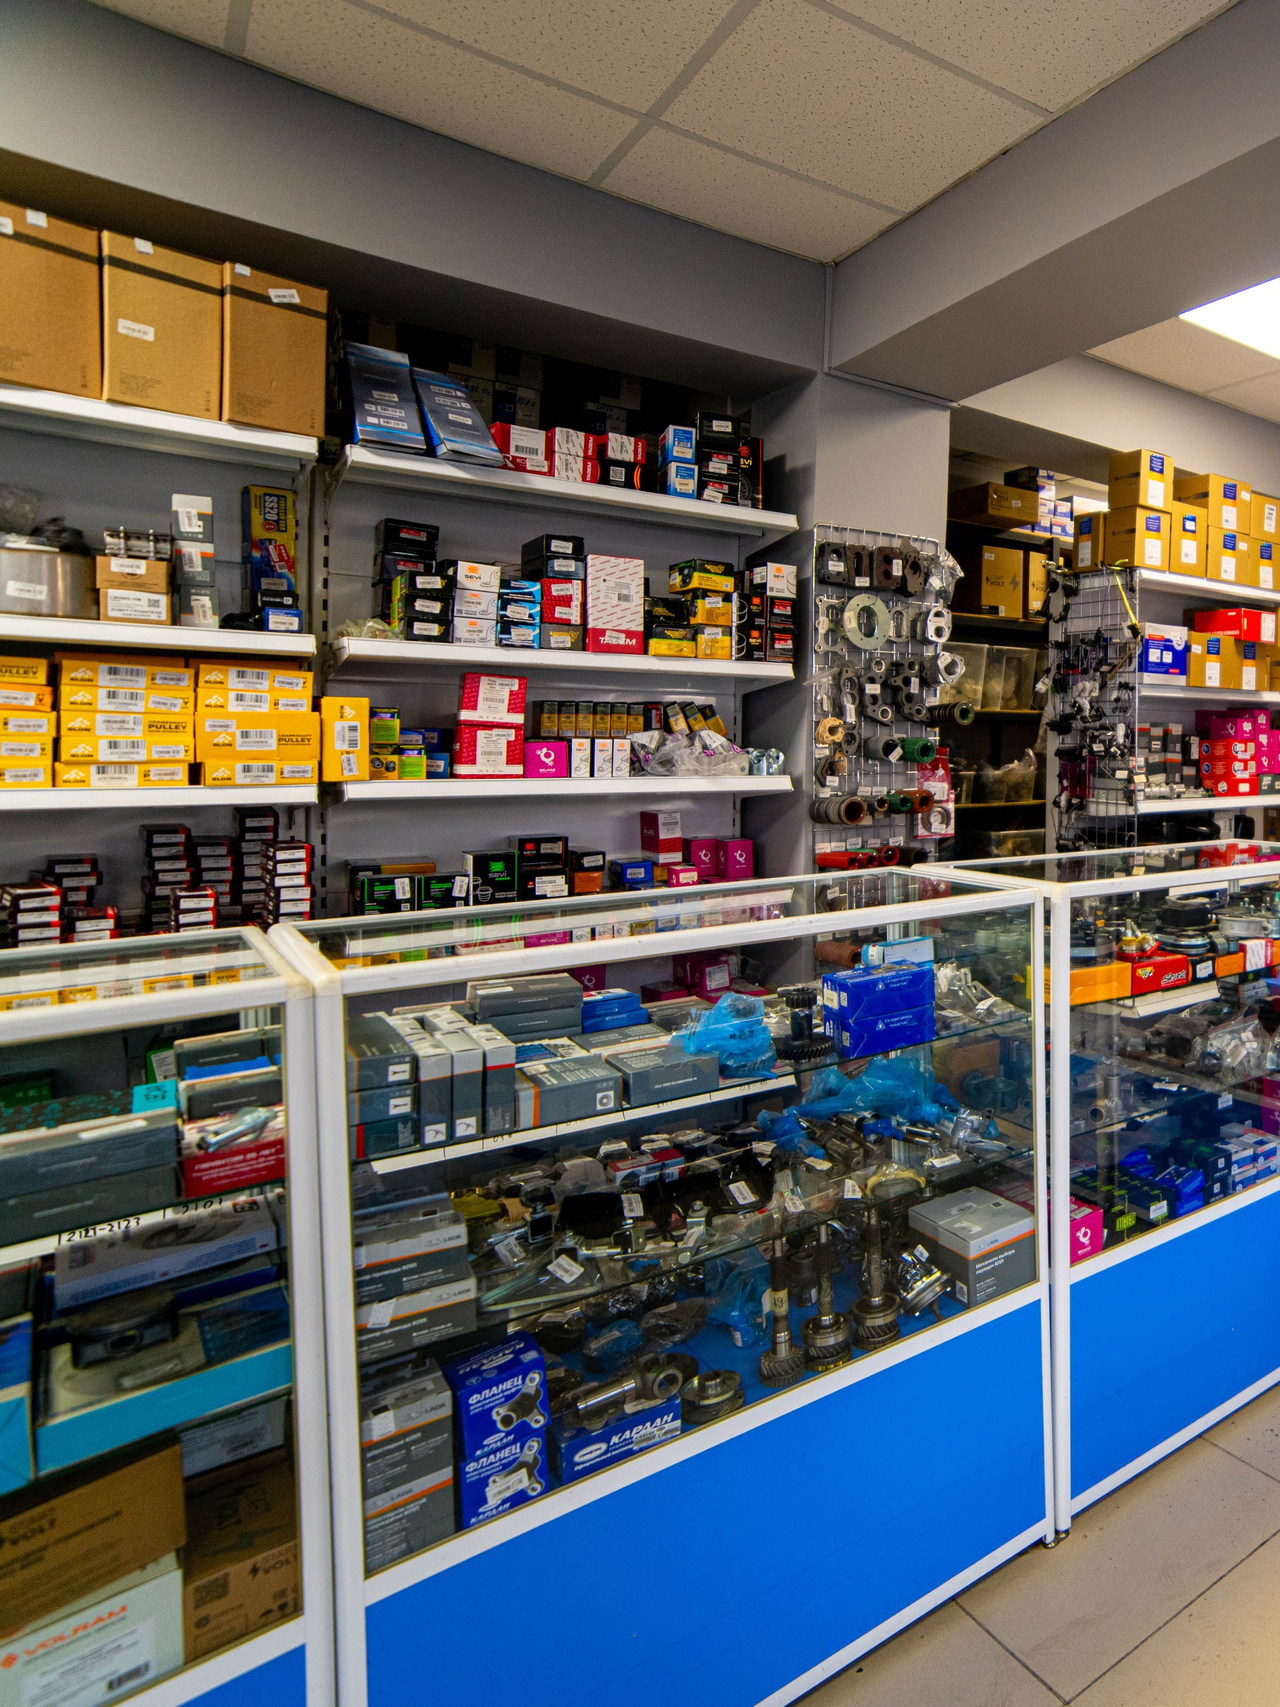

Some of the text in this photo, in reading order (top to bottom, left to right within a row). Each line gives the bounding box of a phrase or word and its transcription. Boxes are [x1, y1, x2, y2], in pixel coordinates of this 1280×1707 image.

[975, 1249, 1016, 1269] Механизм выбора
[975, 1264, 995, 1275] передач
[468, 1375, 523, 1405] ФЛАНЕЦ
[610, 1413, 674, 1446] КАРДАН
[465, 1443, 521, 1472] ФЛАНЕЦ
[475, 1434, 515, 1456] КАРДАН
[470, 1502, 511, 1524] КАРДАН
[23, 1604, 127, 1656] VOLRAM
